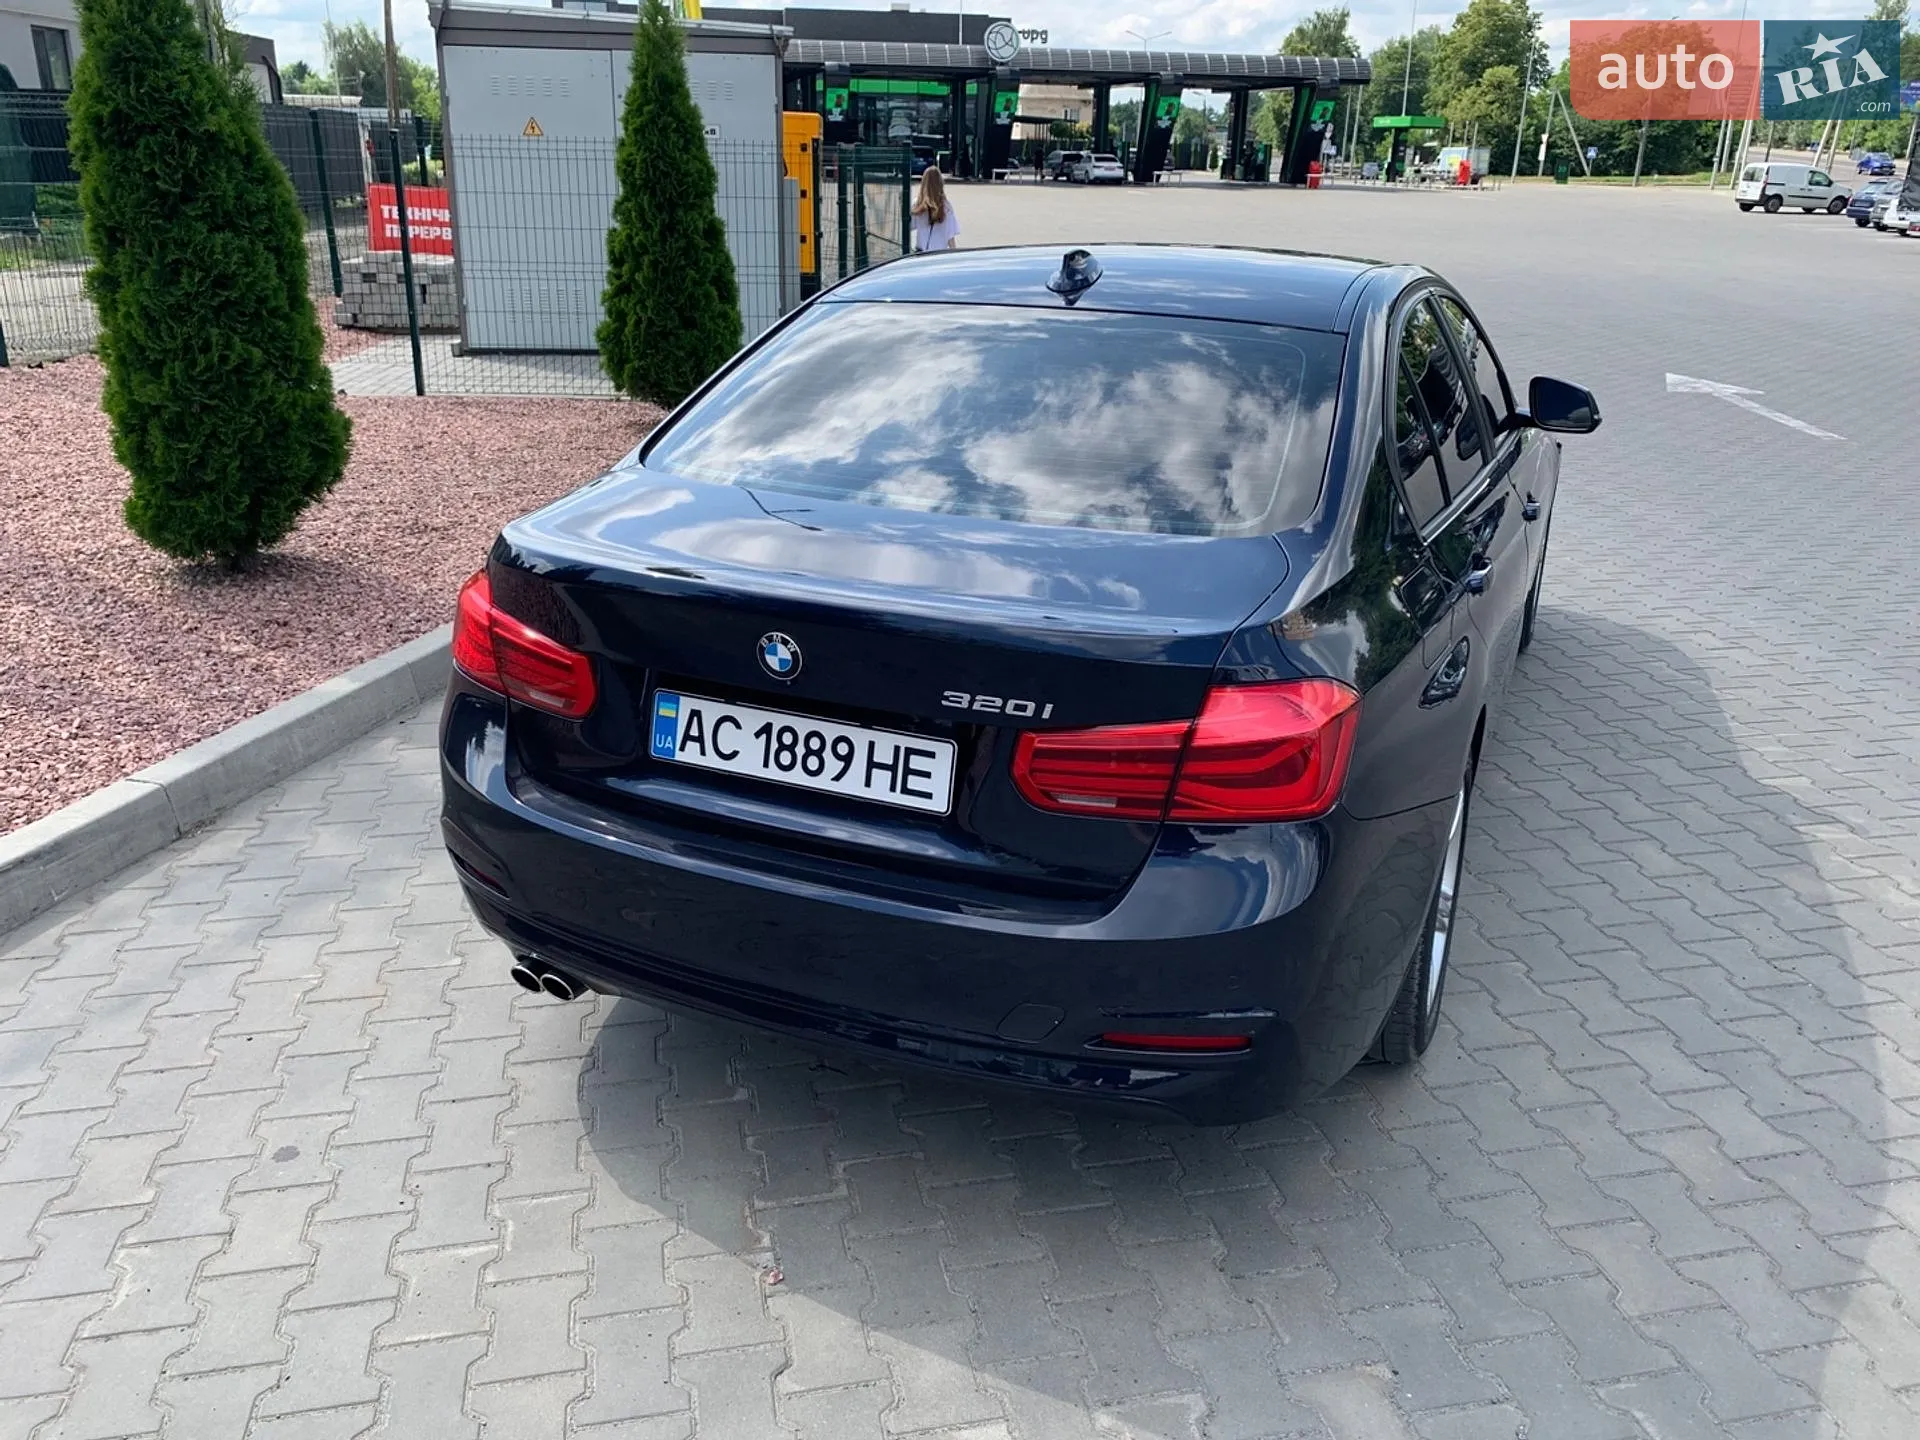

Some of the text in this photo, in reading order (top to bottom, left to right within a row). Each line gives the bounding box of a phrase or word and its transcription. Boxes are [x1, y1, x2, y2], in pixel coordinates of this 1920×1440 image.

[385, 224, 452, 240] ПРЕРВ
[655, 734, 674, 750] UA
[678, 708, 937, 801] AC 1889 HE
